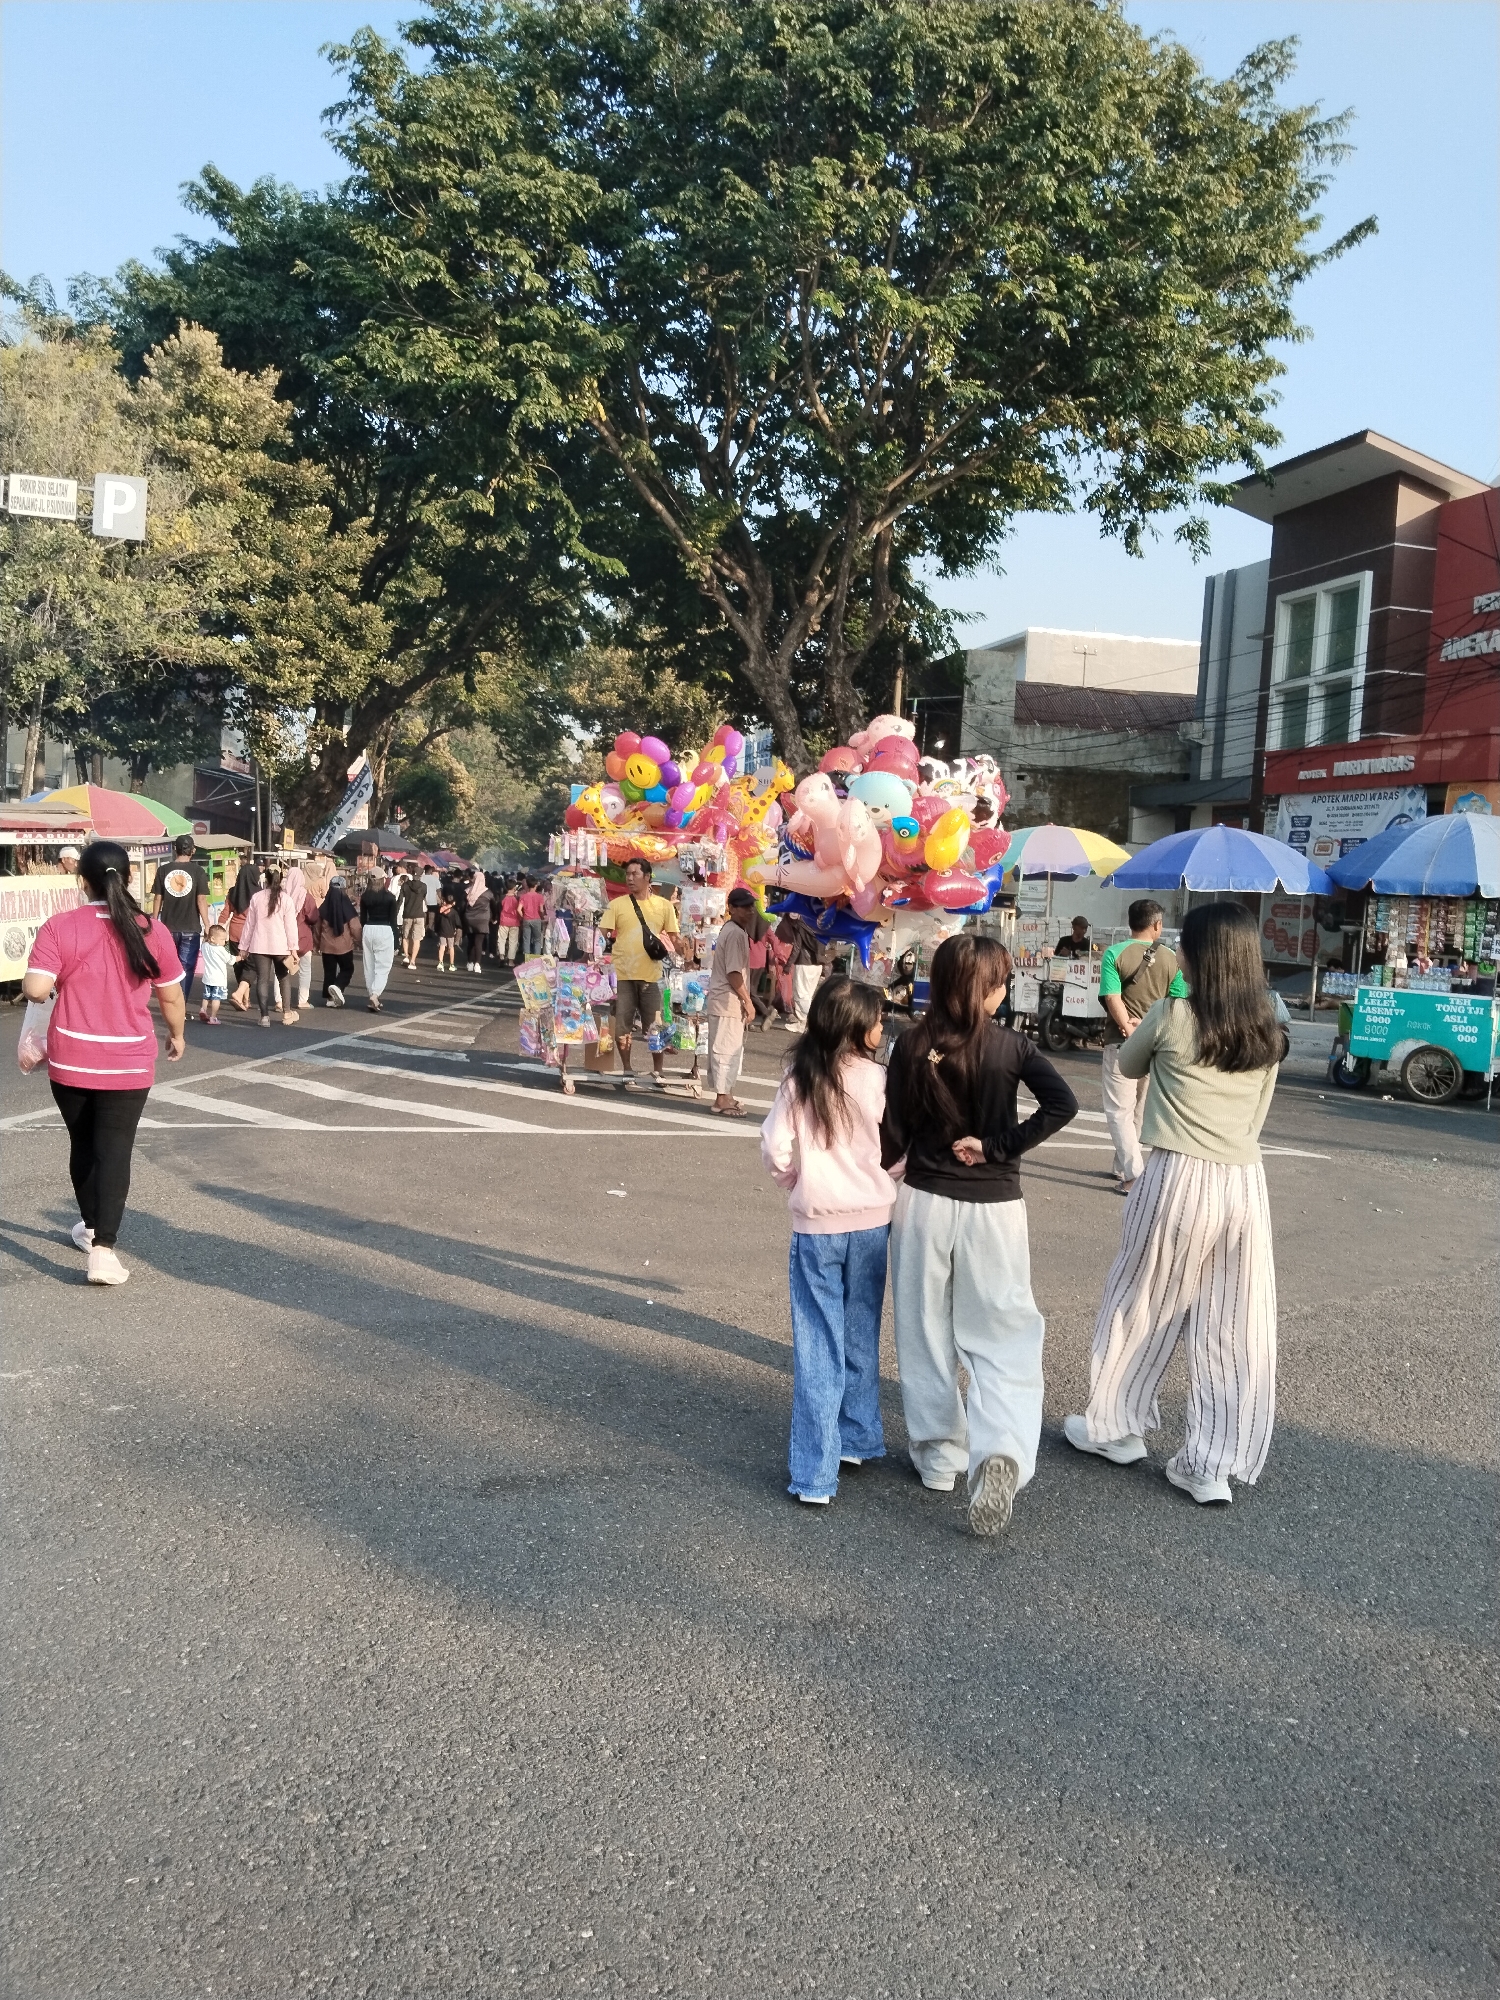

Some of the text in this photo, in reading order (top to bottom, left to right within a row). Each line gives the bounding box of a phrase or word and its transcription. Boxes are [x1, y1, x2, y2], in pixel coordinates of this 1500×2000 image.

[20, 478, 69, 498] PARKIR SISI SELATAN
[10, 496, 37, 512] SEPANJANG
[103, 480, 136, 529] P
[1311, 791, 1400, 804] APOTEK MARDI WARAS
[0, 891, 17, 920] ATE
[1066, 996, 1085, 1004] CILOR
[1368, 990, 1394, 1000] KOPI
[1363, 998, 1397, 1007] LELET
[1448, 998, 1472, 1006] TEH
[1359, 1005, 1393, 1016] LASEM
[1435, 1003, 1484, 1015] TONG TJI
[1365, 1015, 1391, 1025] 5000
[1443, 1014, 1468, 1024] ASLI
[1452, 1025, 1478, 1034] 5000
